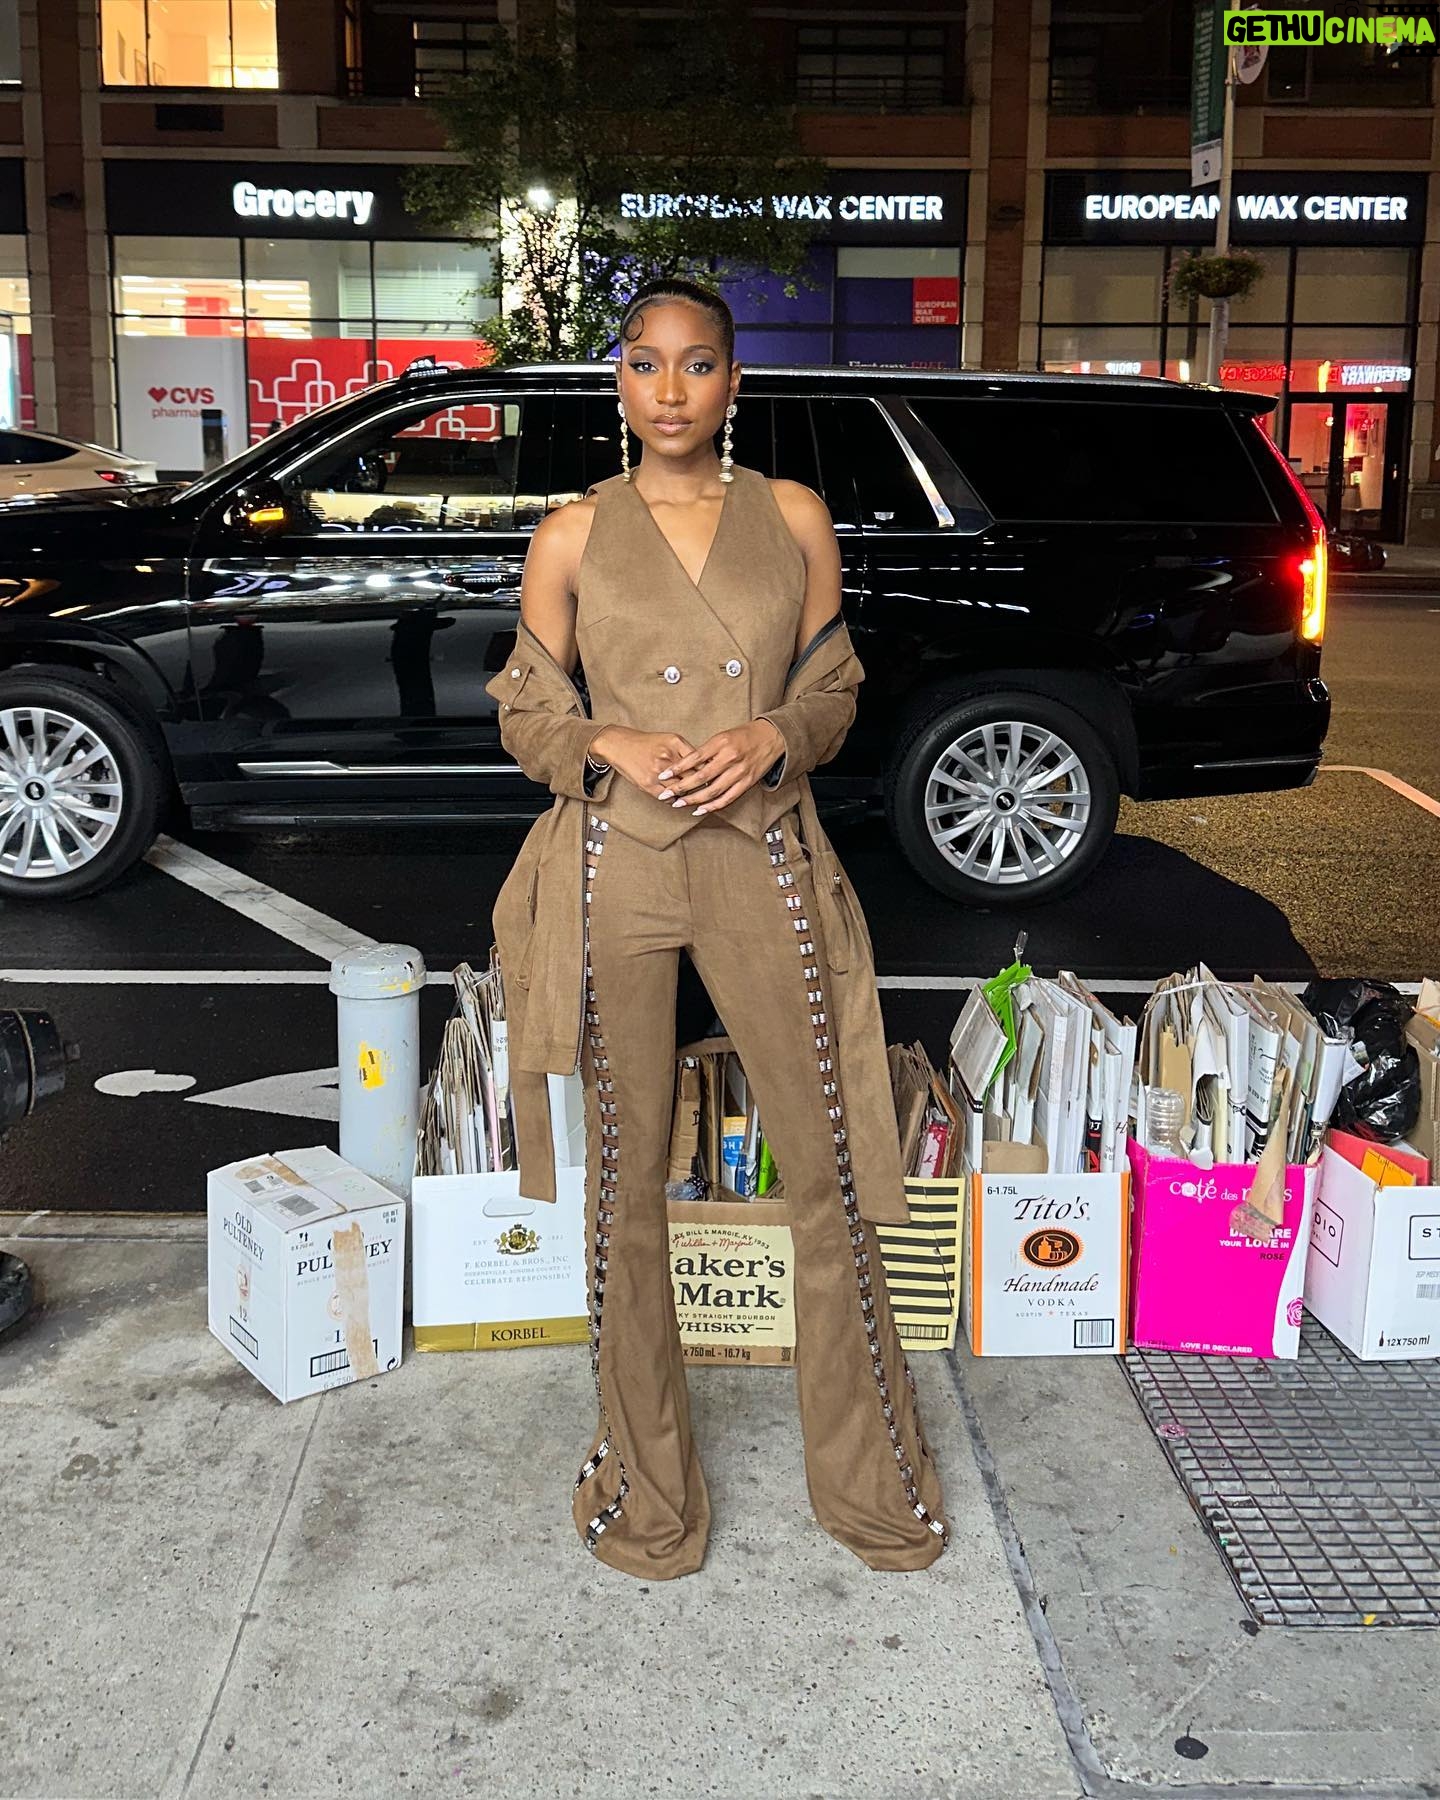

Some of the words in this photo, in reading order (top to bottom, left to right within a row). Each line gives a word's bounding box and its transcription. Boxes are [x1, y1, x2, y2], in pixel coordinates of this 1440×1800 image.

[233, 181, 374, 225] Grocery
[771, 194, 833, 219] WAX
[838, 195, 943, 220] CENTER
[1237, 196, 1298, 220] WAX
[1303, 196, 1407, 220] CENTER
[915, 301, 957, 309] EUROPEAN
[915, 308, 934, 316] WAX
[915, 315, 946, 323] CENTER
[170, 387, 215, 404] CVS
[152, 407, 202, 419] pharma
[987, 1186, 1018, 1195] 6-1.75L
[1220, 1187, 1239, 1200] des
[1013, 1194, 1090, 1220] Tito's
[235, 1211, 252, 1234] OLD
[223, 1217, 264, 1261] PULTENEY
[1219, 1239, 1243, 1248] YOUR
[1245, 1237, 1279, 1249] LOVE
[1280, 1241, 1290, 1249] IN
[296, 1238, 393, 1276] PULEY
[475, 1259, 511, 1269] KORBEL
[670, 1253, 786, 1279] aker's
[1003, 1273, 1099, 1293] Handmade
[677, 1282, 783, 1309] Mark
[1027, 1298, 1076, 1307] VODKA
[239, 1304, 248, 1322] 12
[692, 1312, 734, 1320] STRAIGHT
[724, 1347, 740, 1359] 16.7
[741, 1348, 751, 1361] kg
[1180, 1341, 1201, 1349] LOVE
[1212, 1344, 1253, 1354] DECLARED
